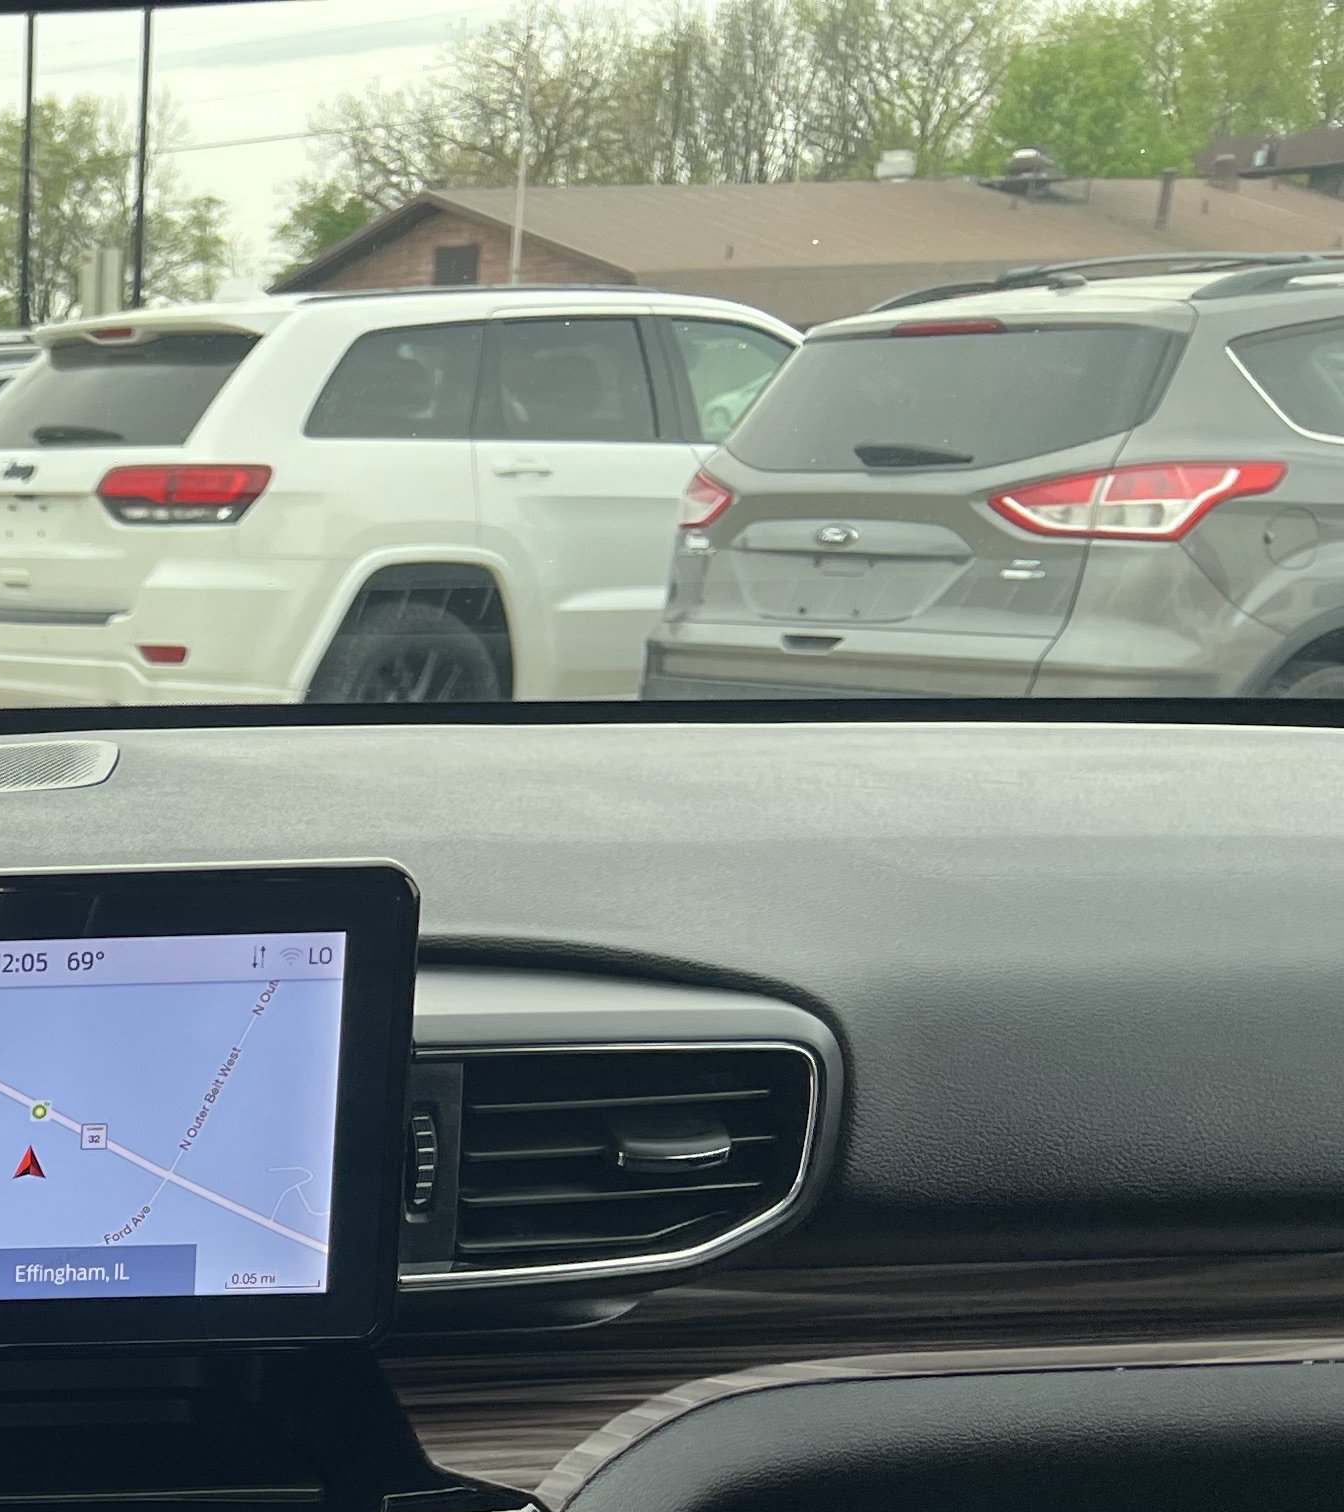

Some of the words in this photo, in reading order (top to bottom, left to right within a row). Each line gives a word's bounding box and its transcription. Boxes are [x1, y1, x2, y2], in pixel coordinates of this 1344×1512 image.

[66, 951, 105, 971] 69°
[308, 946, 333, 966] LO
[252, 1003, 265, 1016] N
[179, 1138, 193, 1151] N
[186, 1105, 210, 1139] Outer
[204, 1079, 224, 1104] Belt
[218, 1046, 241, 1079] West
[87, 1134, 101, 1144] 32
[103, 1223, 132, 1246] Ford
[130, 1205, 151, 1228] Ave
[15, 1264, 111, 1288] Effingham,
[114, 1263, 130, 1281] IL
[231, 1273, 258, 1286] 0.05
[260, 1274, 276, 1284] mi
